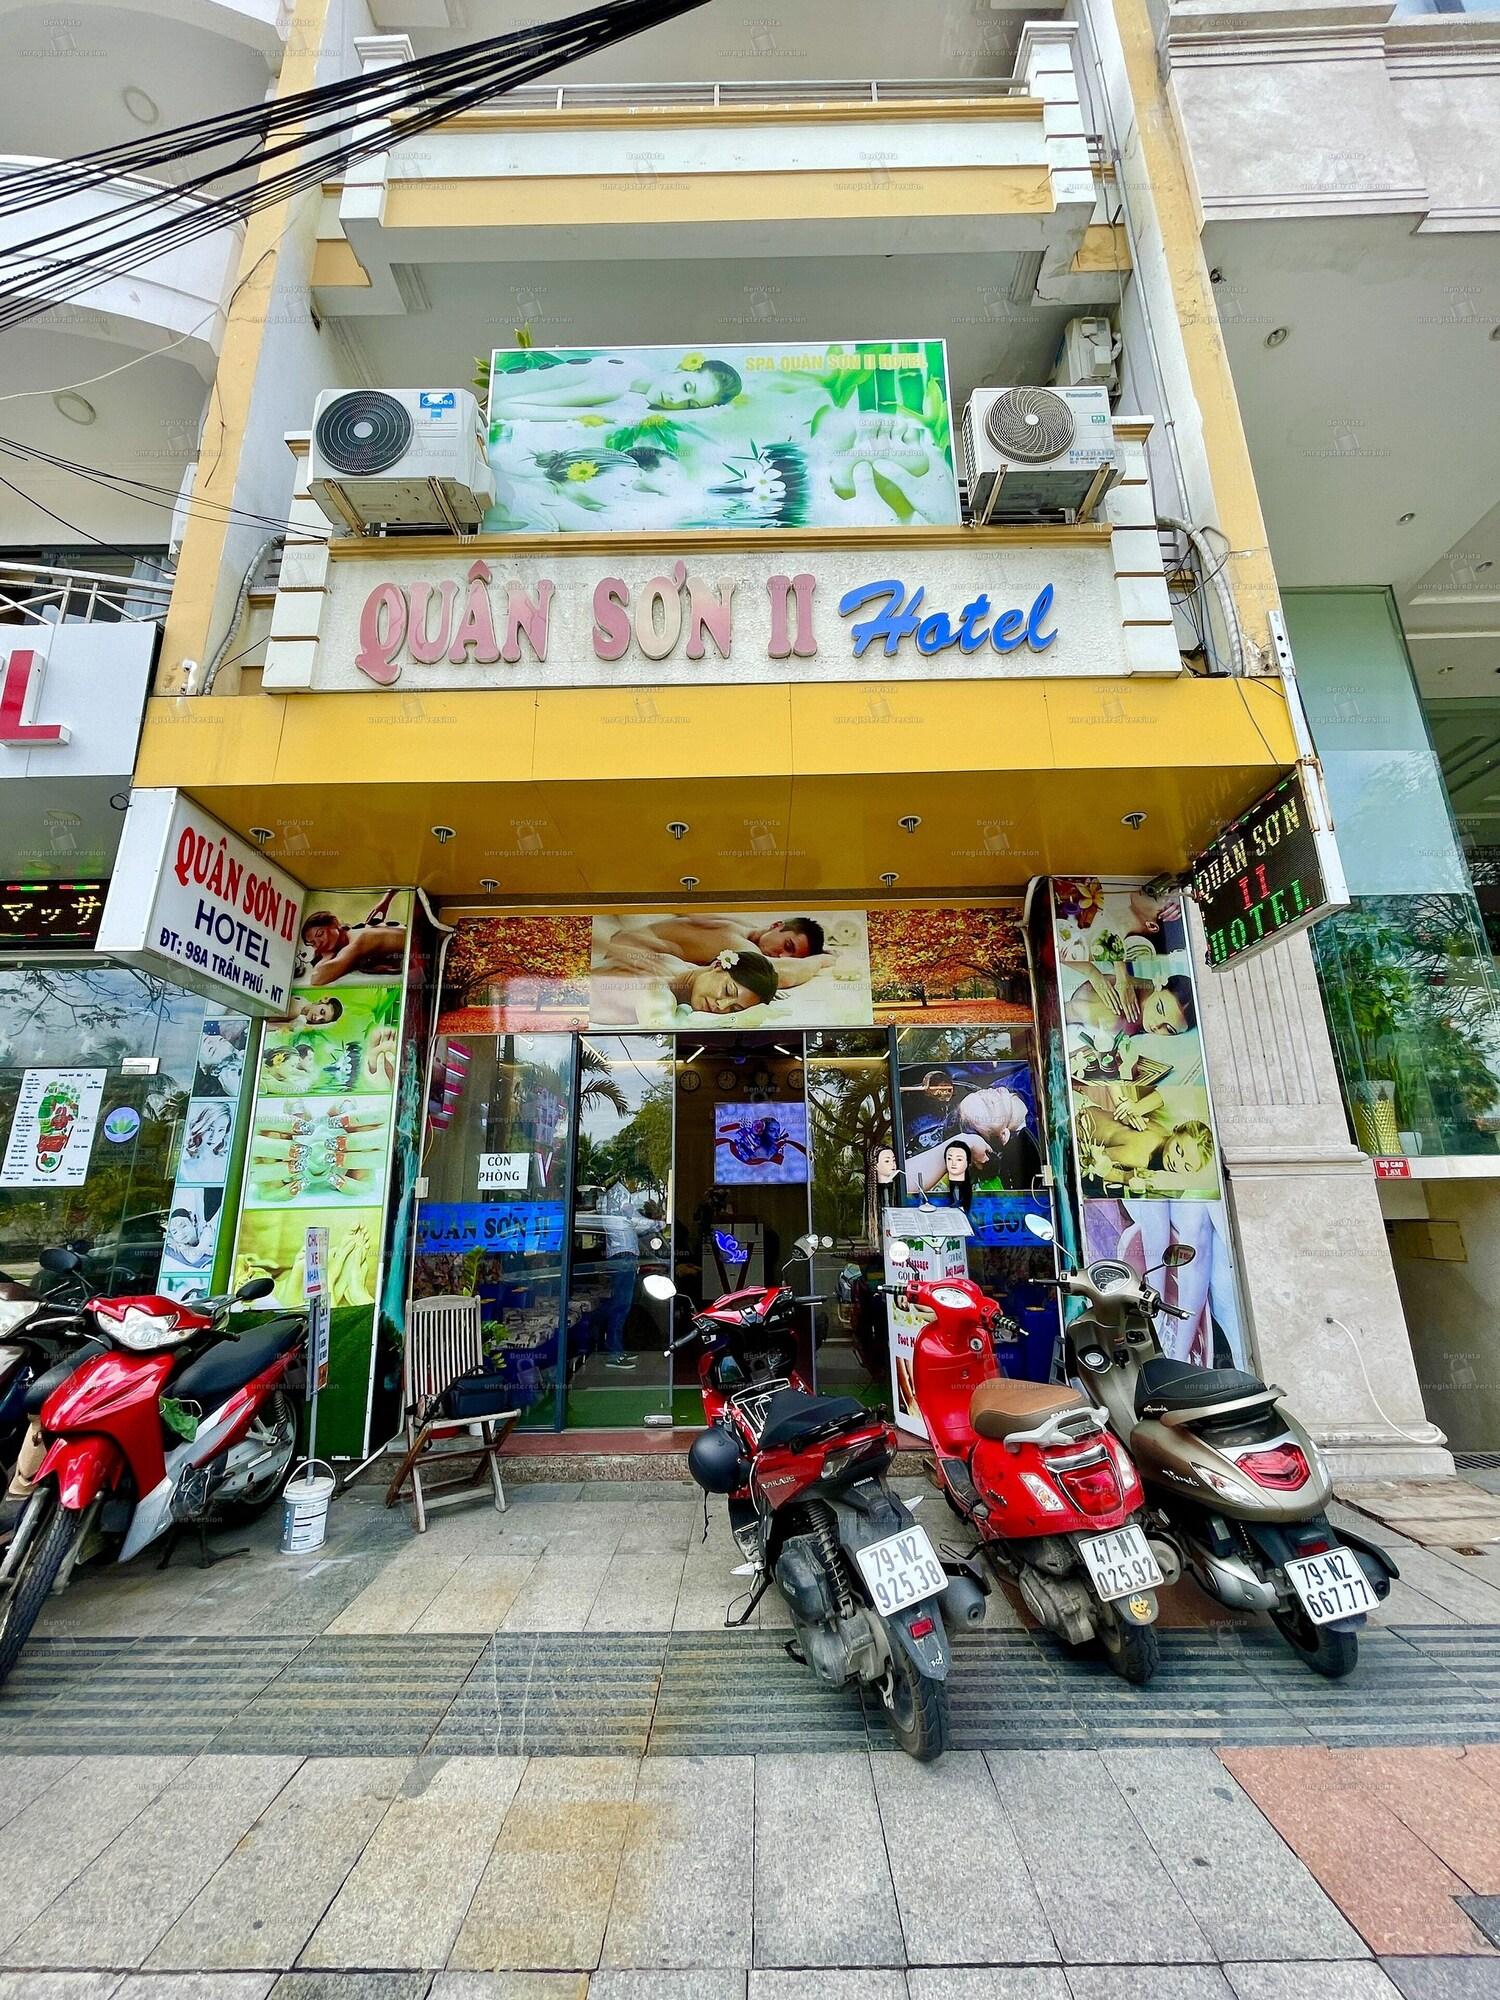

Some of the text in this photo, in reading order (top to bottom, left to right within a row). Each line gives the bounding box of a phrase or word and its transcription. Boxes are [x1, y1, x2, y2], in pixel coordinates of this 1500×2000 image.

[355, 559, 1059, 685] QUÂN SƠN II Hotel
[1198, 796, 1300, 904] QUÂN SƠN
[174, 826, 298, 942] QUÂN SƠN II
[194, 898, 271, 969] HOTEL
[1210, 879, 1311, 962] HOTEL
[159, 926, 183, 955] ĐT:
[185, 940, 208, 969] 98A
[212, 952, 241, 983] TRẦN
[242, 971, 265, 995] PHÚ
[270, 984, 284, 1004] NT
[478, 1168, 520, 1182] PHÒNG
[487, 1154, 512, 1167] CÒN
[869, 1535, 923, 1578] 79-N2
[1096, 1556, 1159, 1595] 025.92
[1296, 1554, 1352, 1589] 79-N2
[875, 1559, 941, 1609] 925.38
[1306, 1579, 1369, 1618] 667.77
